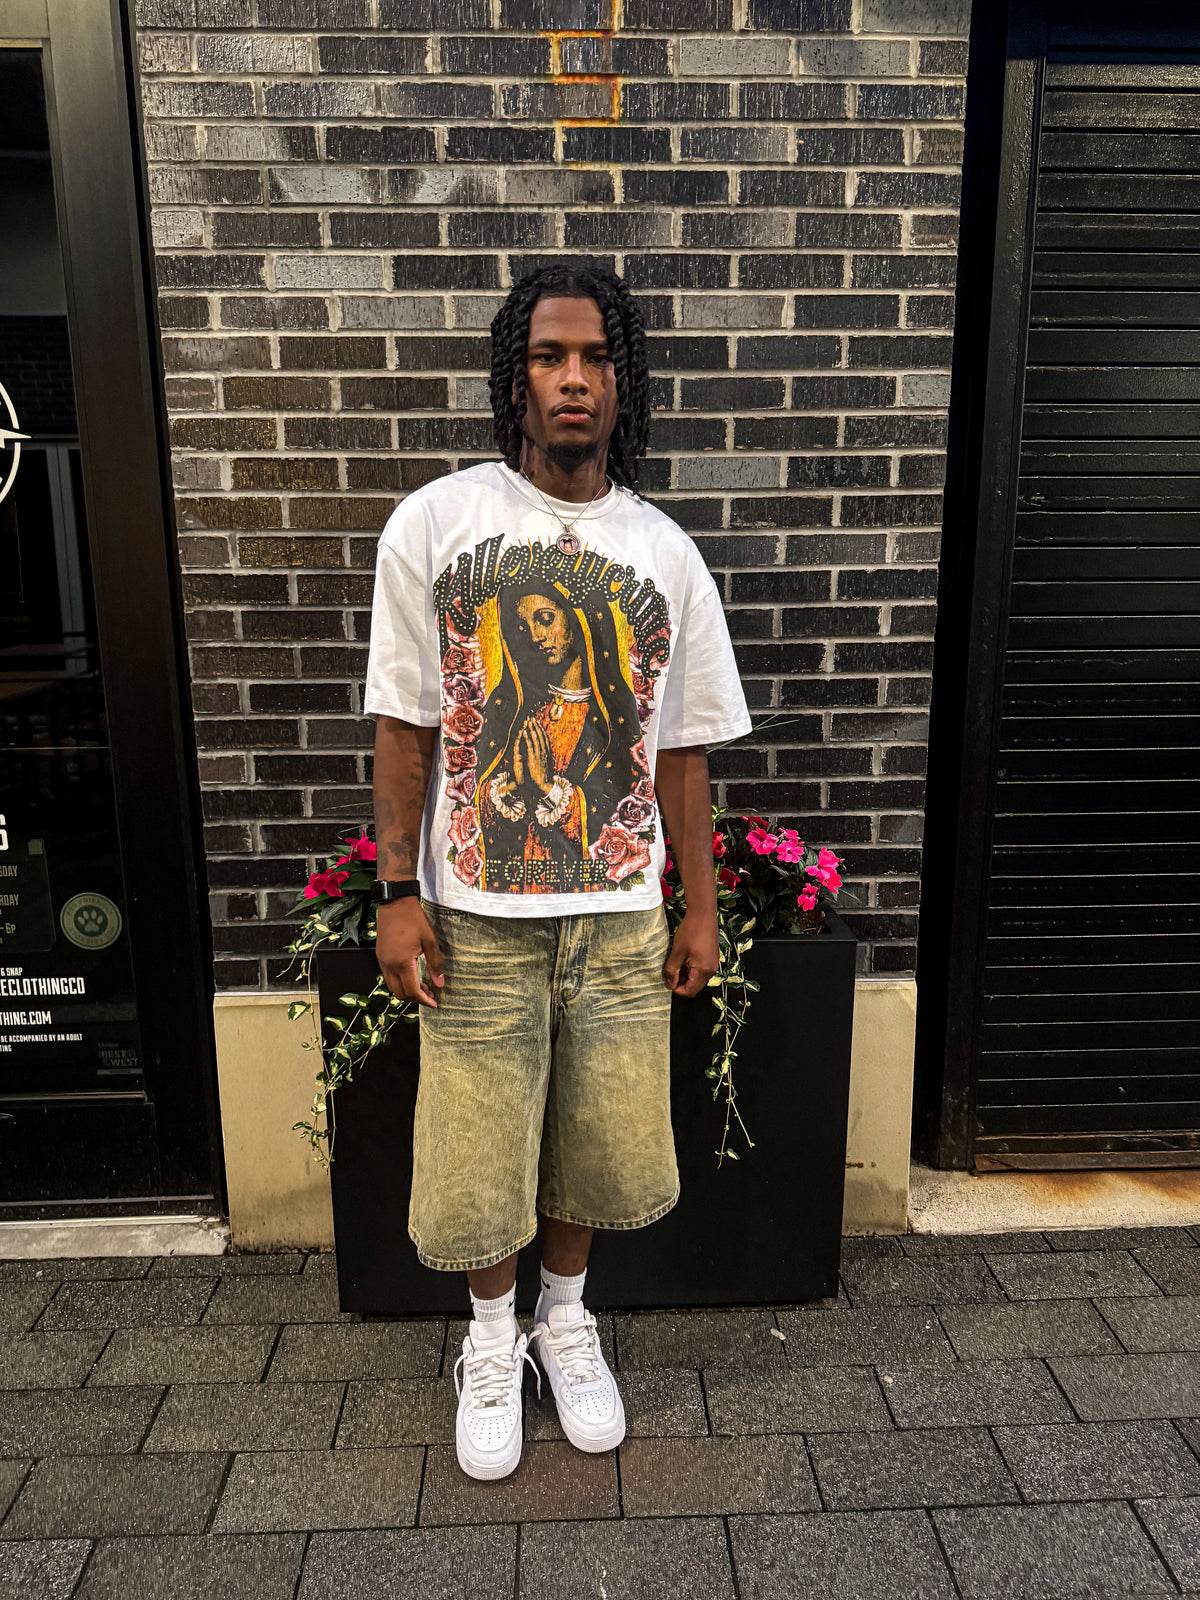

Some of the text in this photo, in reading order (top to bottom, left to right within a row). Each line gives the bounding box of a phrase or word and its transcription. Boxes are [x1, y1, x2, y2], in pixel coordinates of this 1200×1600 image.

[485, 859, 609, 884] FOREVER
[6, 967, 23, 976] SNAP
[0, 977, 86, 996] ECLOTHINGCO
[9, 1034, 48, 1042] ACCOMPANIED
[57, 1033, 65, 1041] AN
[66, 1033, 83, 1041] ADULT
